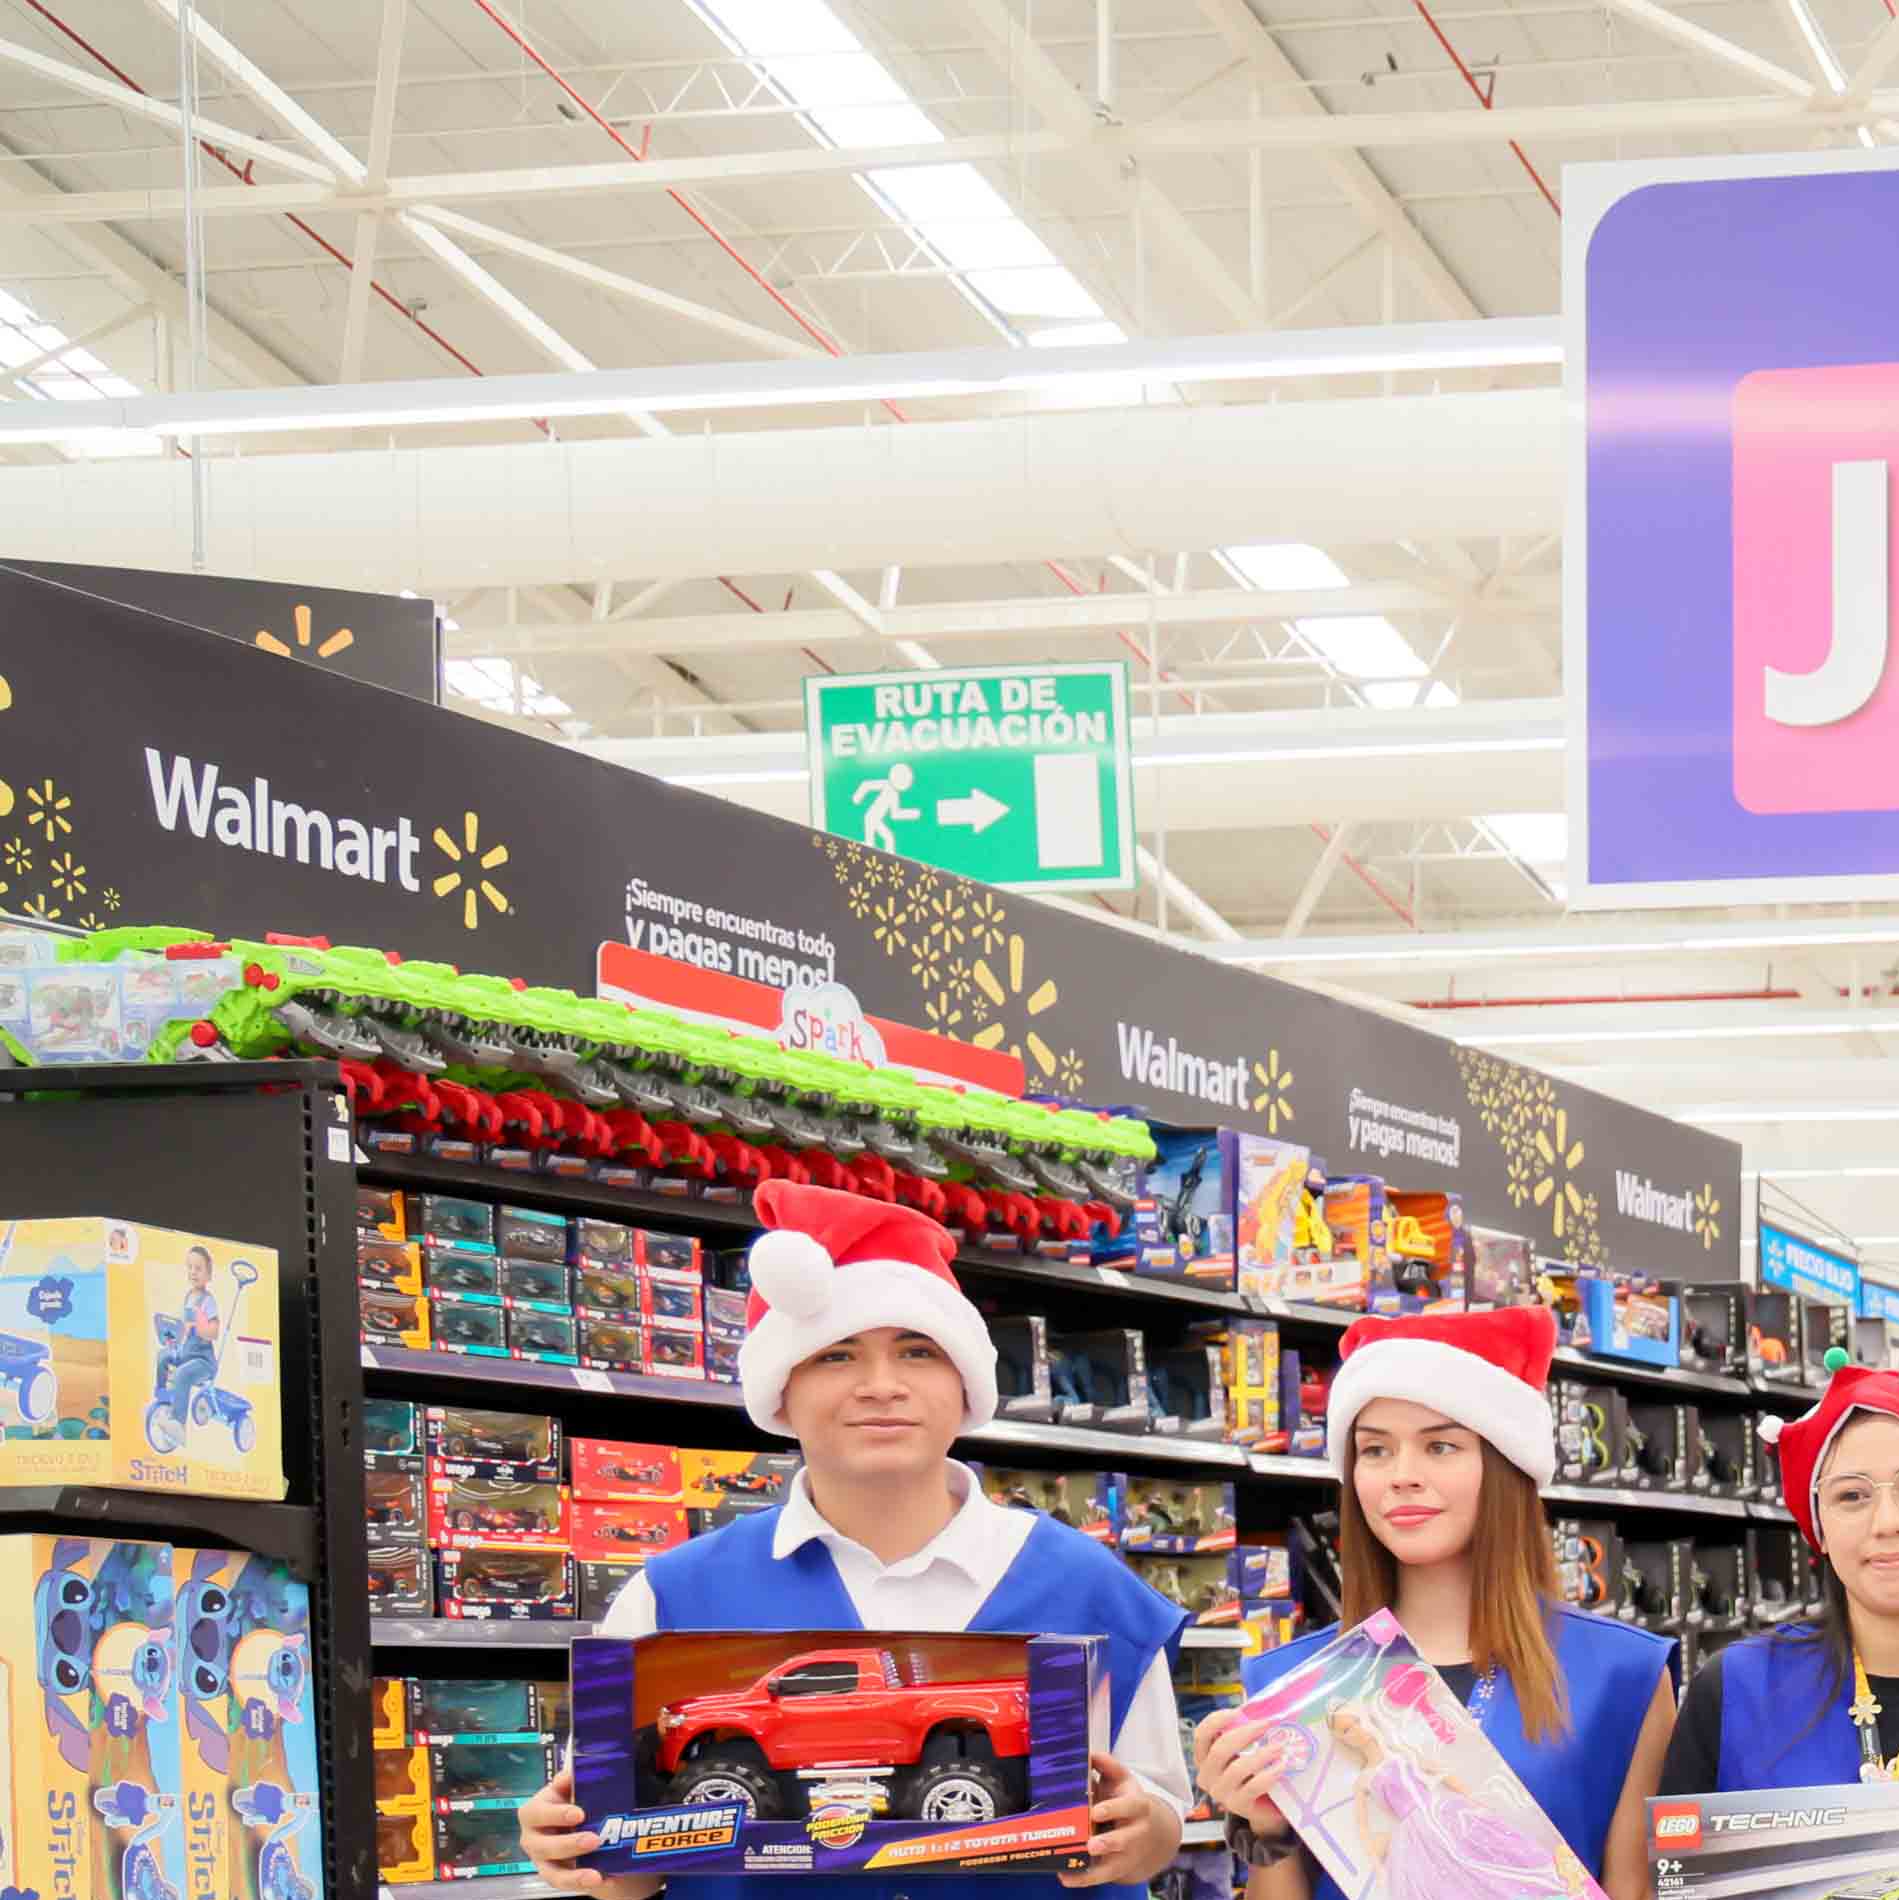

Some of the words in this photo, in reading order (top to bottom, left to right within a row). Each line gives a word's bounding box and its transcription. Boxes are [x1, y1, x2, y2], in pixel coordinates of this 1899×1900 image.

[874, 682, 988, 718] RUTA
[1001, 678, 1057, 711] DE
[831, 703, 1106, 757] EVACUACIÓN
[145, 747, 420, 893] Walmart
[705, 906, 796, 951] encuentras
[797, 928, 836, 958] todo
[1117, 1022, 1249, 1111] Walmart
[1361, 1118, 1404, 1157] pagas
[1405, 1125, 1460, 1168] menos!
[1616, 1169, 1694, 1232] Walmart
[601, 1808, 737, 1846] ADVENTURE
[645, 1830, 724, 1851] FORCE
[887, 1843, 927, 1858] AUTO
[963, 1833, 1019, 1850] TOYOTA
[1020, 1826, 1077, 1843] TUNDRA
[1656, 1815, 1699, 1836] LEGO
[1710, 1807, 1847, 1833] TECHNIC
[1657, 1859, 1683, 1875] 9+
